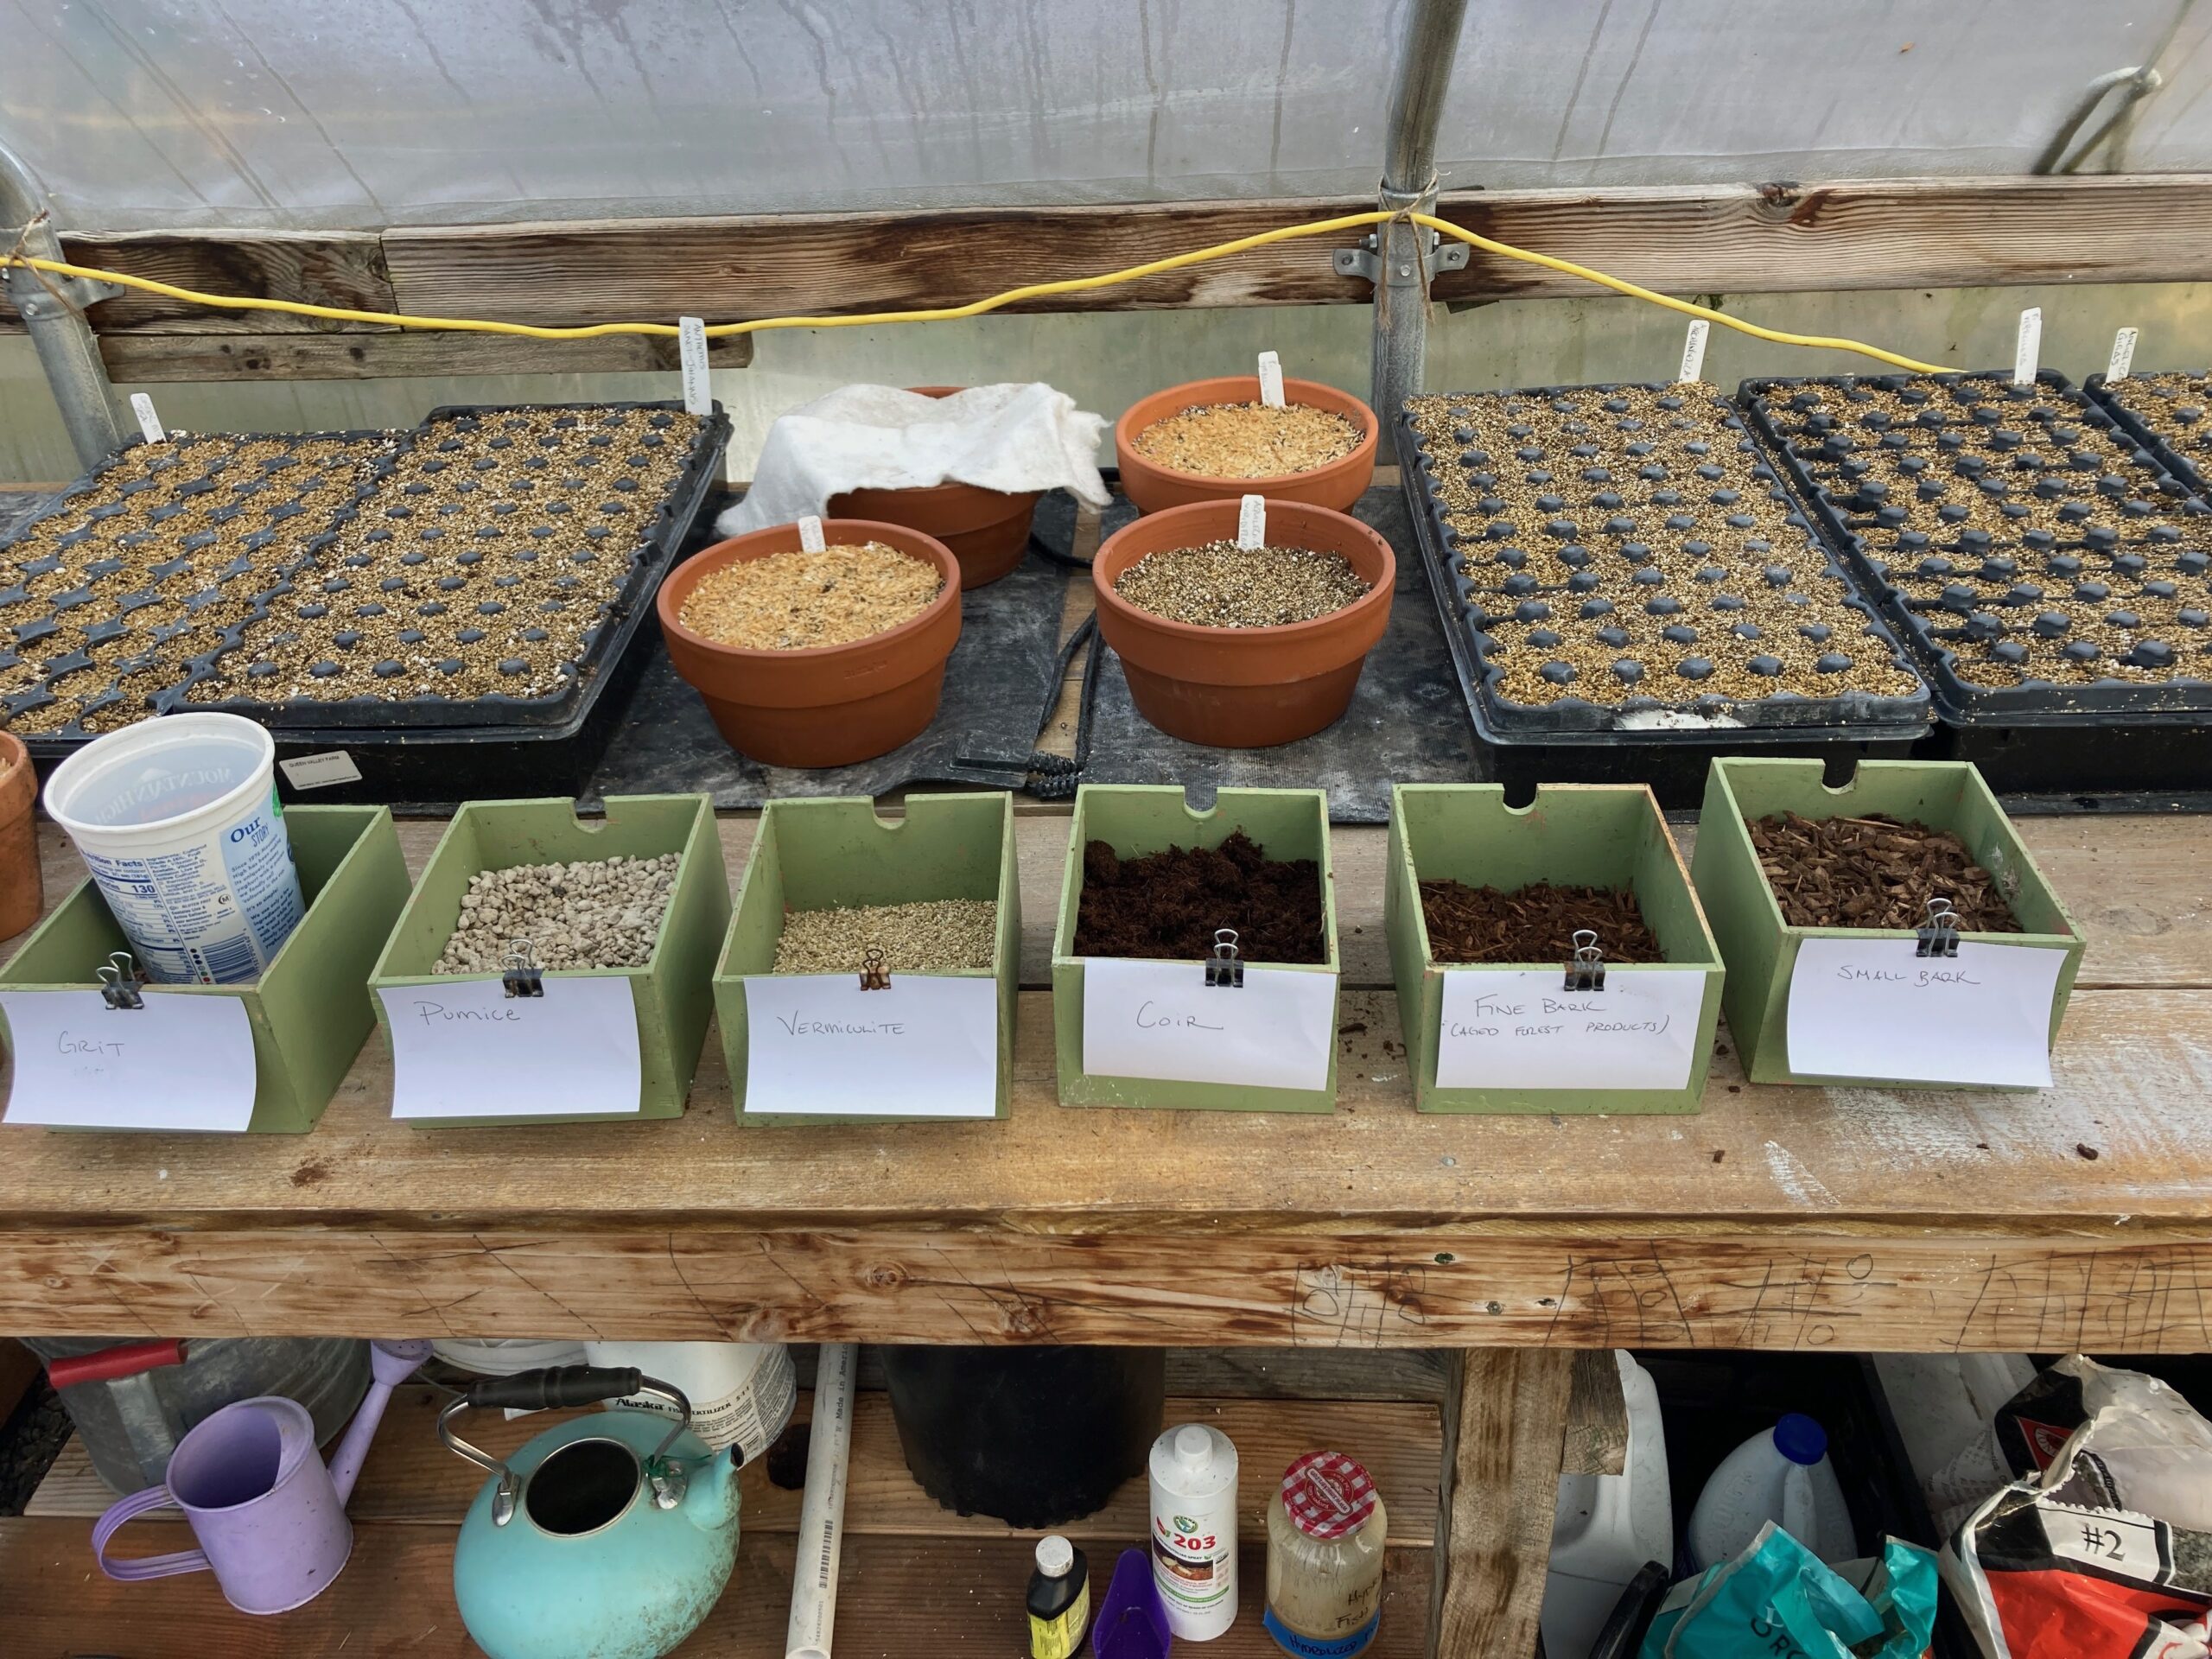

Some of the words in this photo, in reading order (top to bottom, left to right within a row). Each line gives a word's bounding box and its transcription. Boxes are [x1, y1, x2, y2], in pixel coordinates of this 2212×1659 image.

[231, 817, 261, 842] Our
[251, 823, 270, 848] STORY
[131, 884, 156, 893] 130
[1837, 964, 1907, 982] SMALL
[1914, 970, 1981, 988] BARK
[413, 1001, 521, 1026] Pumice
[1541, 998, 1607, 1014] BARK
[1586, 1014, 1670, 1035] PRODUCTS)
[837, 1344, 849, 1376] Americ
[837, 1380, 846, 1391] in
[615, 1398, 664, 1411] Alaska
[691, 1401, 732, 1415] ERTILIZER
[835, 1395, 844, 1420] Made
[1173, 1533, 1217, 1551] 203
[2081, 1522, 2126, 1562] #2
